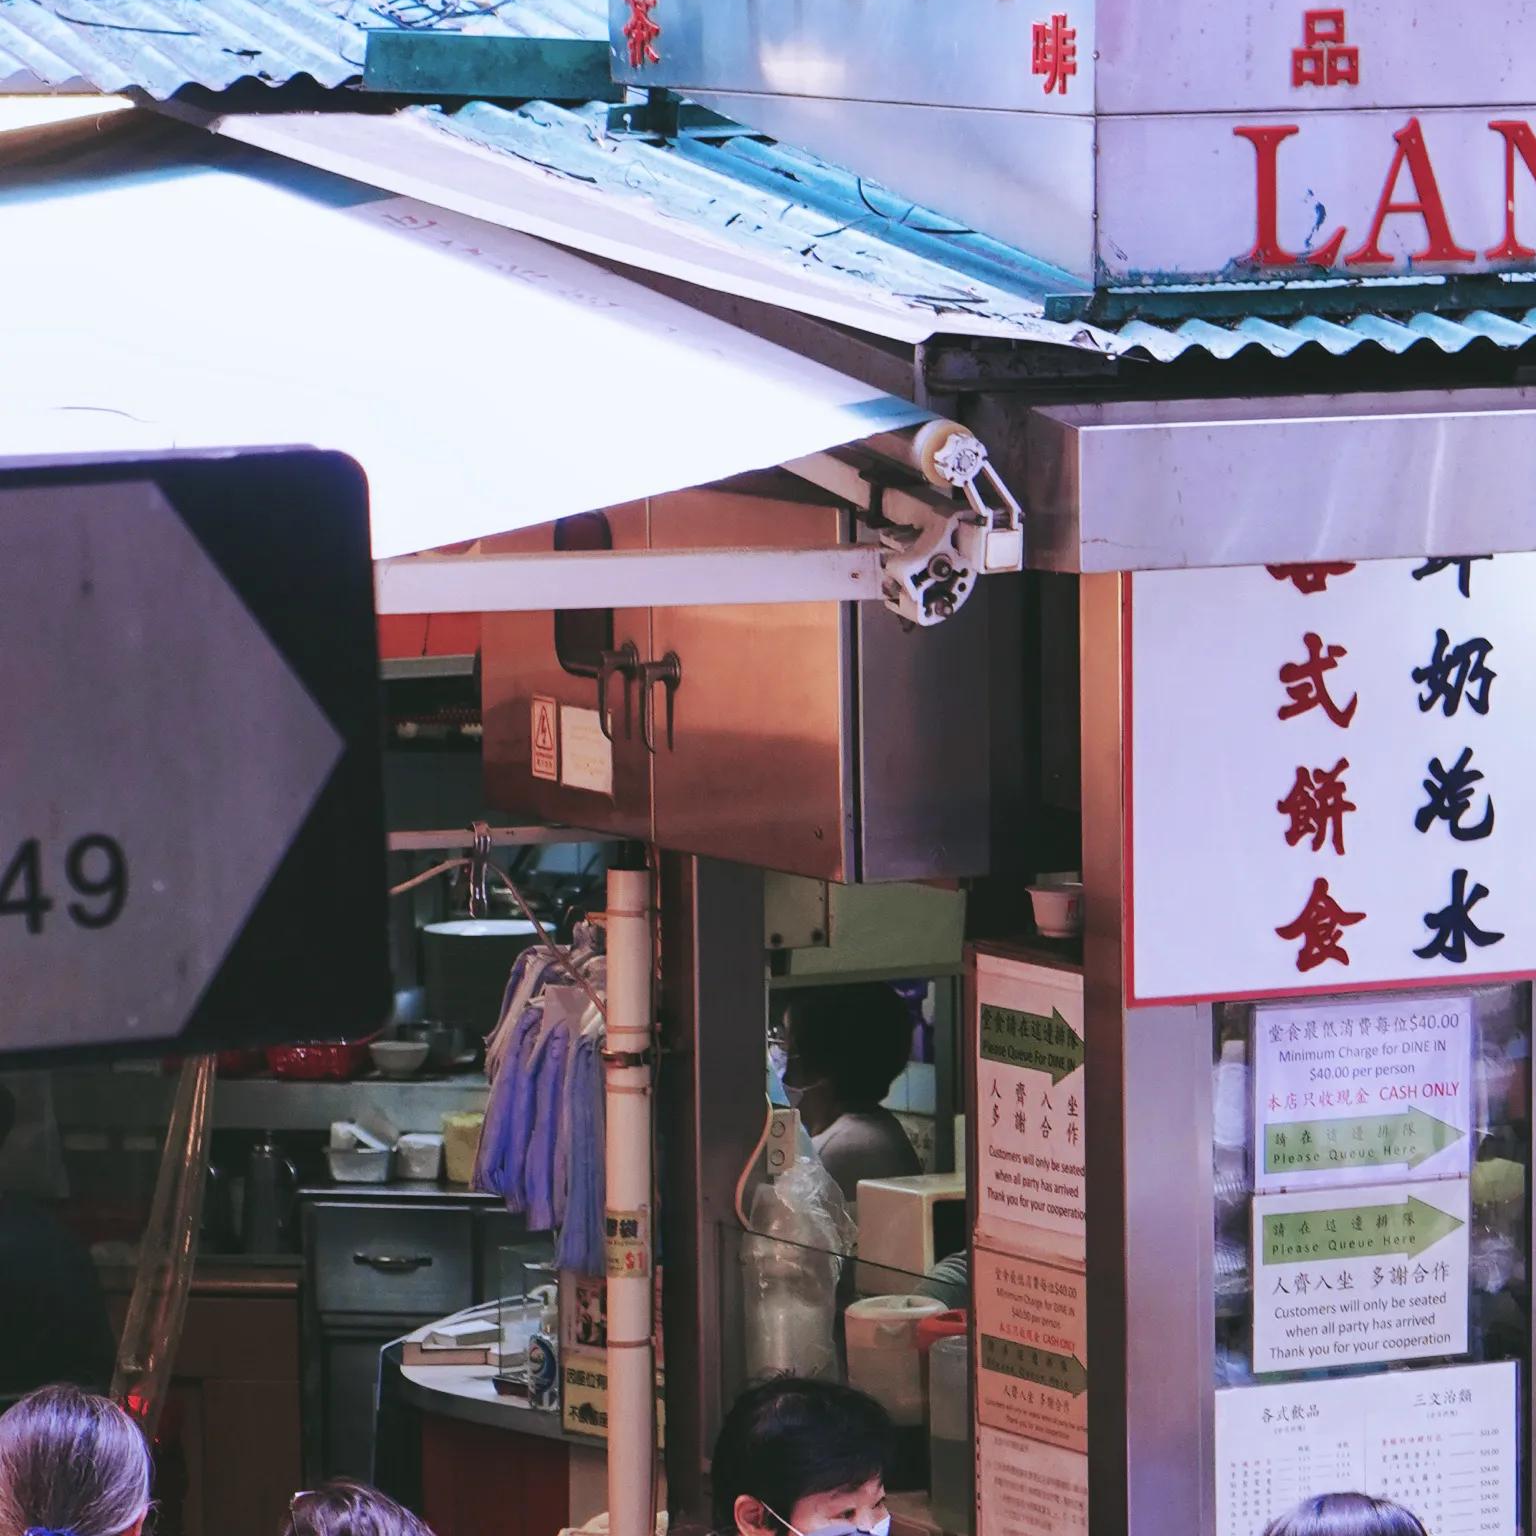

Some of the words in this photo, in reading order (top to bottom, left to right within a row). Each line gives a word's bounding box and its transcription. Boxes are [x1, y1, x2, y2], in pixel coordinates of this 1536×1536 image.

[1278, 1048, 1335, 1063] Minimum
[1338, 1044, 1379, 1062] Charge
[1381, 1042, 1398, 1055] for
[1401, 1040, 1430, 1053] DINE
[1433, 1039, 1447, 1052] IN
[1309, 1066, 1350, 1082] $40.00
[1352, 1067, 1373, 1081] per
[1375, 1063, 1415, 1079] person
[1268, 1087, 1370, 1112] 本店只收現金
[1379, 1082, 1418, 1102] CASH
[1421, 1081, 1460, 1099] ONLY
[988, 1145, 1022, 1164] Customers
[1022, 1153, 1034, 1165] will
[1035, 1157, 1050, 1172] only
[1050, 1159, 1060, 1172] be
[1273, 1148, 1320, 1164] Please
[1328, 1144, 1375, 1162] Queue
[1383, 1142, 1418, 1156] Here
[994, 1168, 1012, 1183] when
[1013, 1172, 1021, 1184] all
[1022, 1176, 1040, 1192] party
[1040, 1179, 1053, 1193] has
[1053, 1183, 1079, 1198] arrived
[987, 1185, 1006, 1203] Thank
[1006, 1194, 1019, 1206] you
[1019, 1195, 1030, 1208] for
[1030, 1200, 1046, 1212] your
[1272, 1241, 1320, 1256] Please
[1328, 1237, 1375, 1252] Queue
[1383, 1233, 1417, 1247] Here
[1272, 1269, 1355, 1297] 人齊入坐
[1372, 1260, 1450, 1288] 多謝合作
[1274, 1302, 1337, 1320] Customers
[1339, 1299, 1360, 1314] will
[1362, 1296, 1389, 1313] only
[1391, 1295, 1406, 1308] be
[1408, 1292, 1448, 1308] seated
[1285, 1322, 1318, 1338] when
[1321, 1321, 1336, 1336] all
[1338, 1319, 1370, 1335] party
[1372, 1316, 1393, 1330] has
[1395, 1313, 1437, 1329] arrived
[1269, 1344, 1305, 1360] Thank
[1307, 1345, 1330, 1360] you
[1333, 1340, 1351, 1354] for
[1353, 1340, 1380, 1355] your
[1382, 1332, 1452, 1350] cooperation
[1261, 1404, 1320, 1424] 各式飲品
